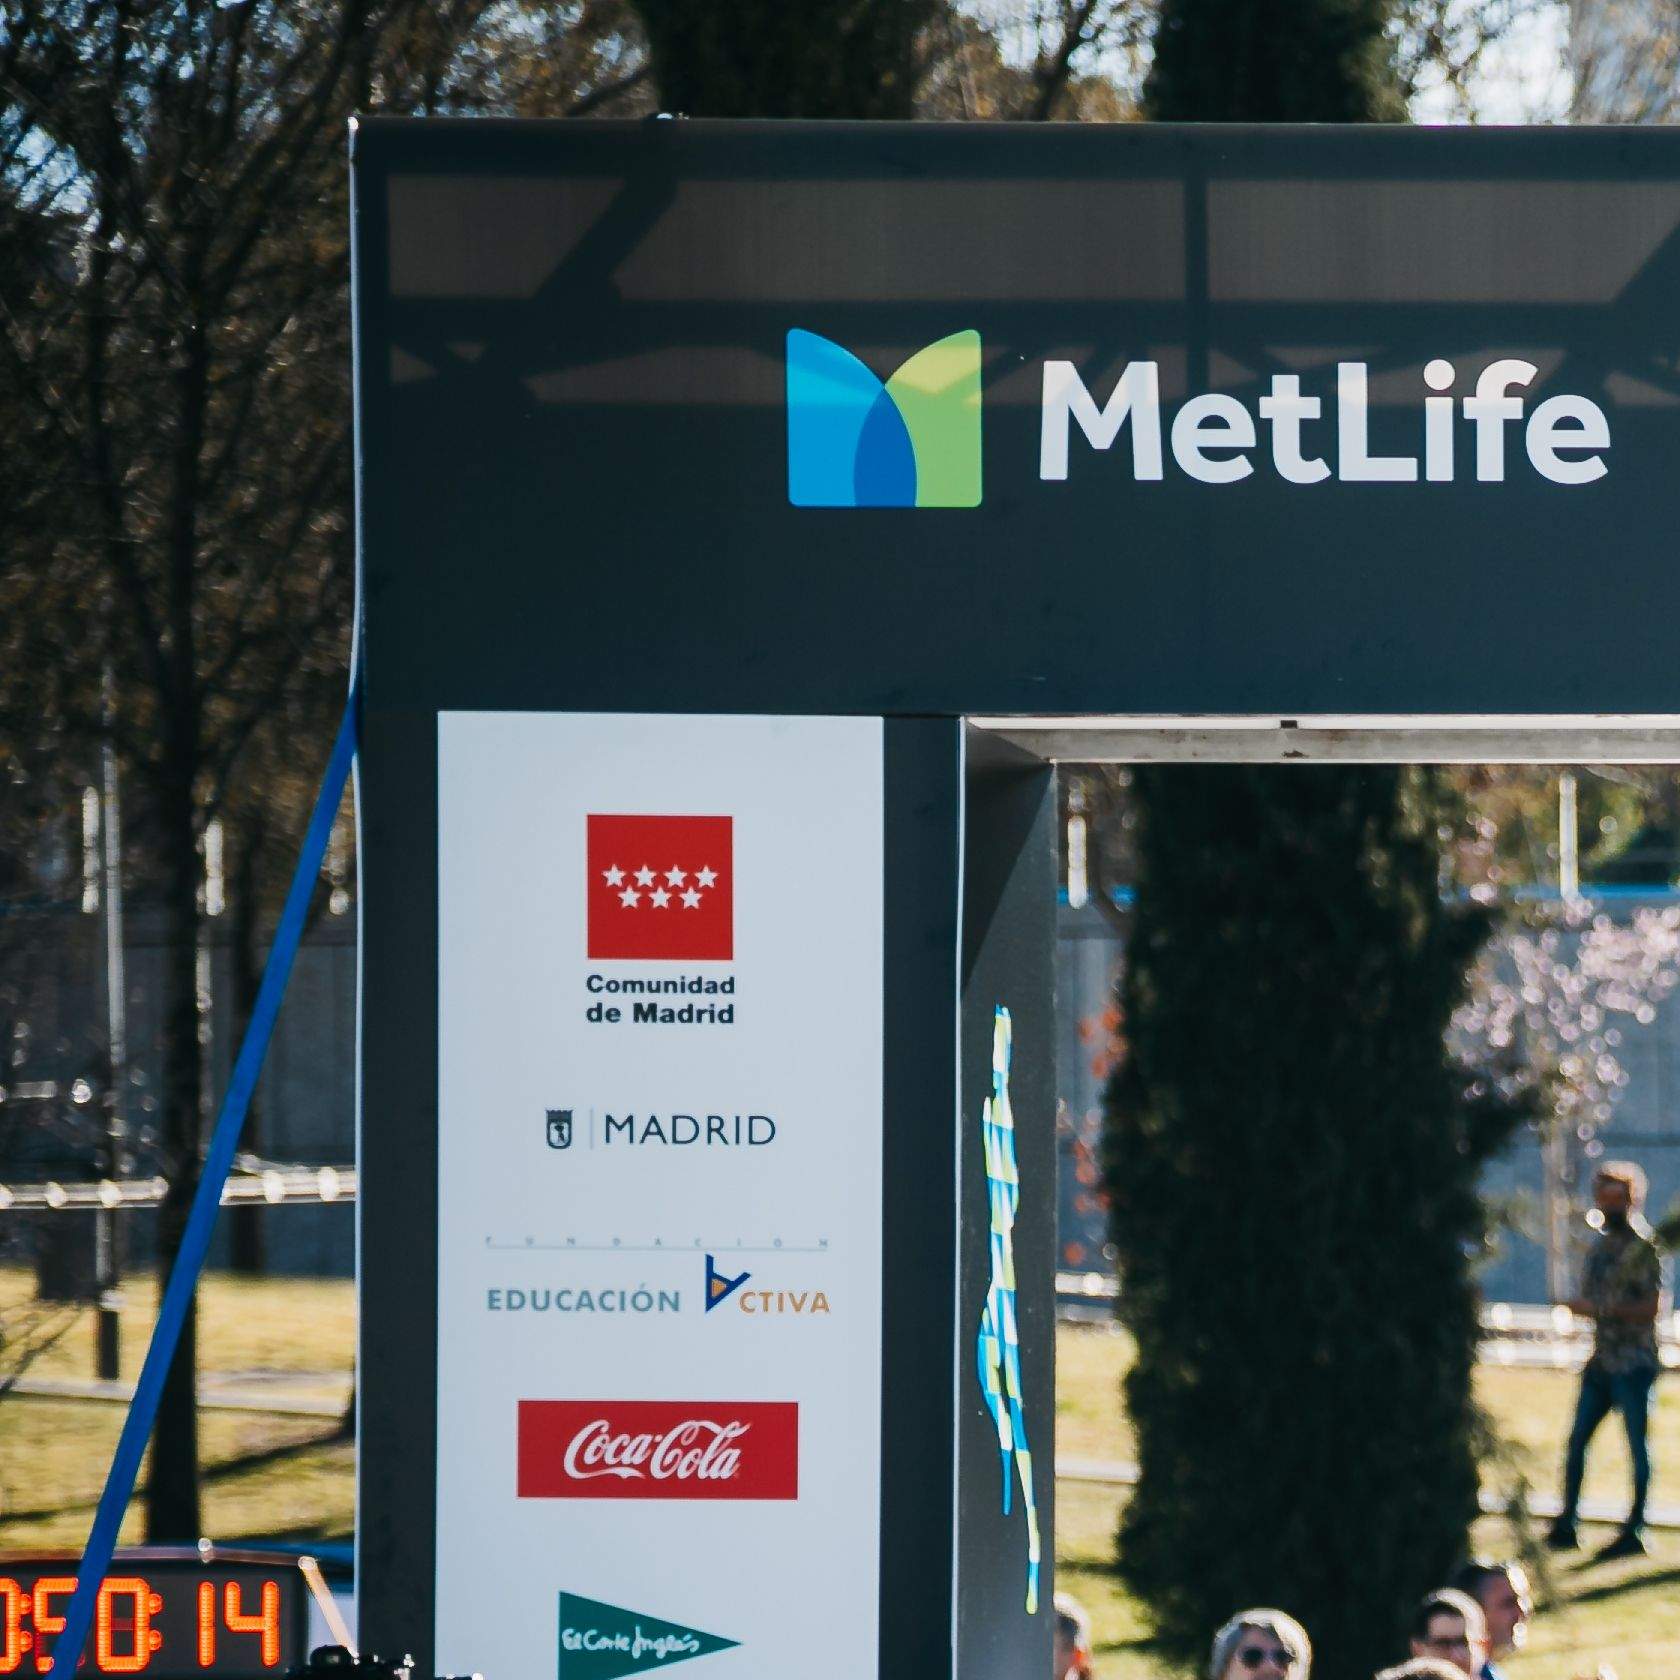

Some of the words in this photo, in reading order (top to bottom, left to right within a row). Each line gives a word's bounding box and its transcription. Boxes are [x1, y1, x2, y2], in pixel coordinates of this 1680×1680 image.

[1039, 358, 1612, 486] MetLife
[586, 974, 735, 994] Comunidad
[586, 1003, 621, 1024] de
[633, 1002, 735, 1024] Madrid
[604, 1114, 776, 1145] MADRID
[487, 1283, 680, 1313] EDUCACIÓN
[563, 1419, 751, 1480] Coca-Cola
[562, 1628, 582, 1650] El
[583, 1629, 630, 1651] Corte
[631, 1624, 700, 1659] Inglés
